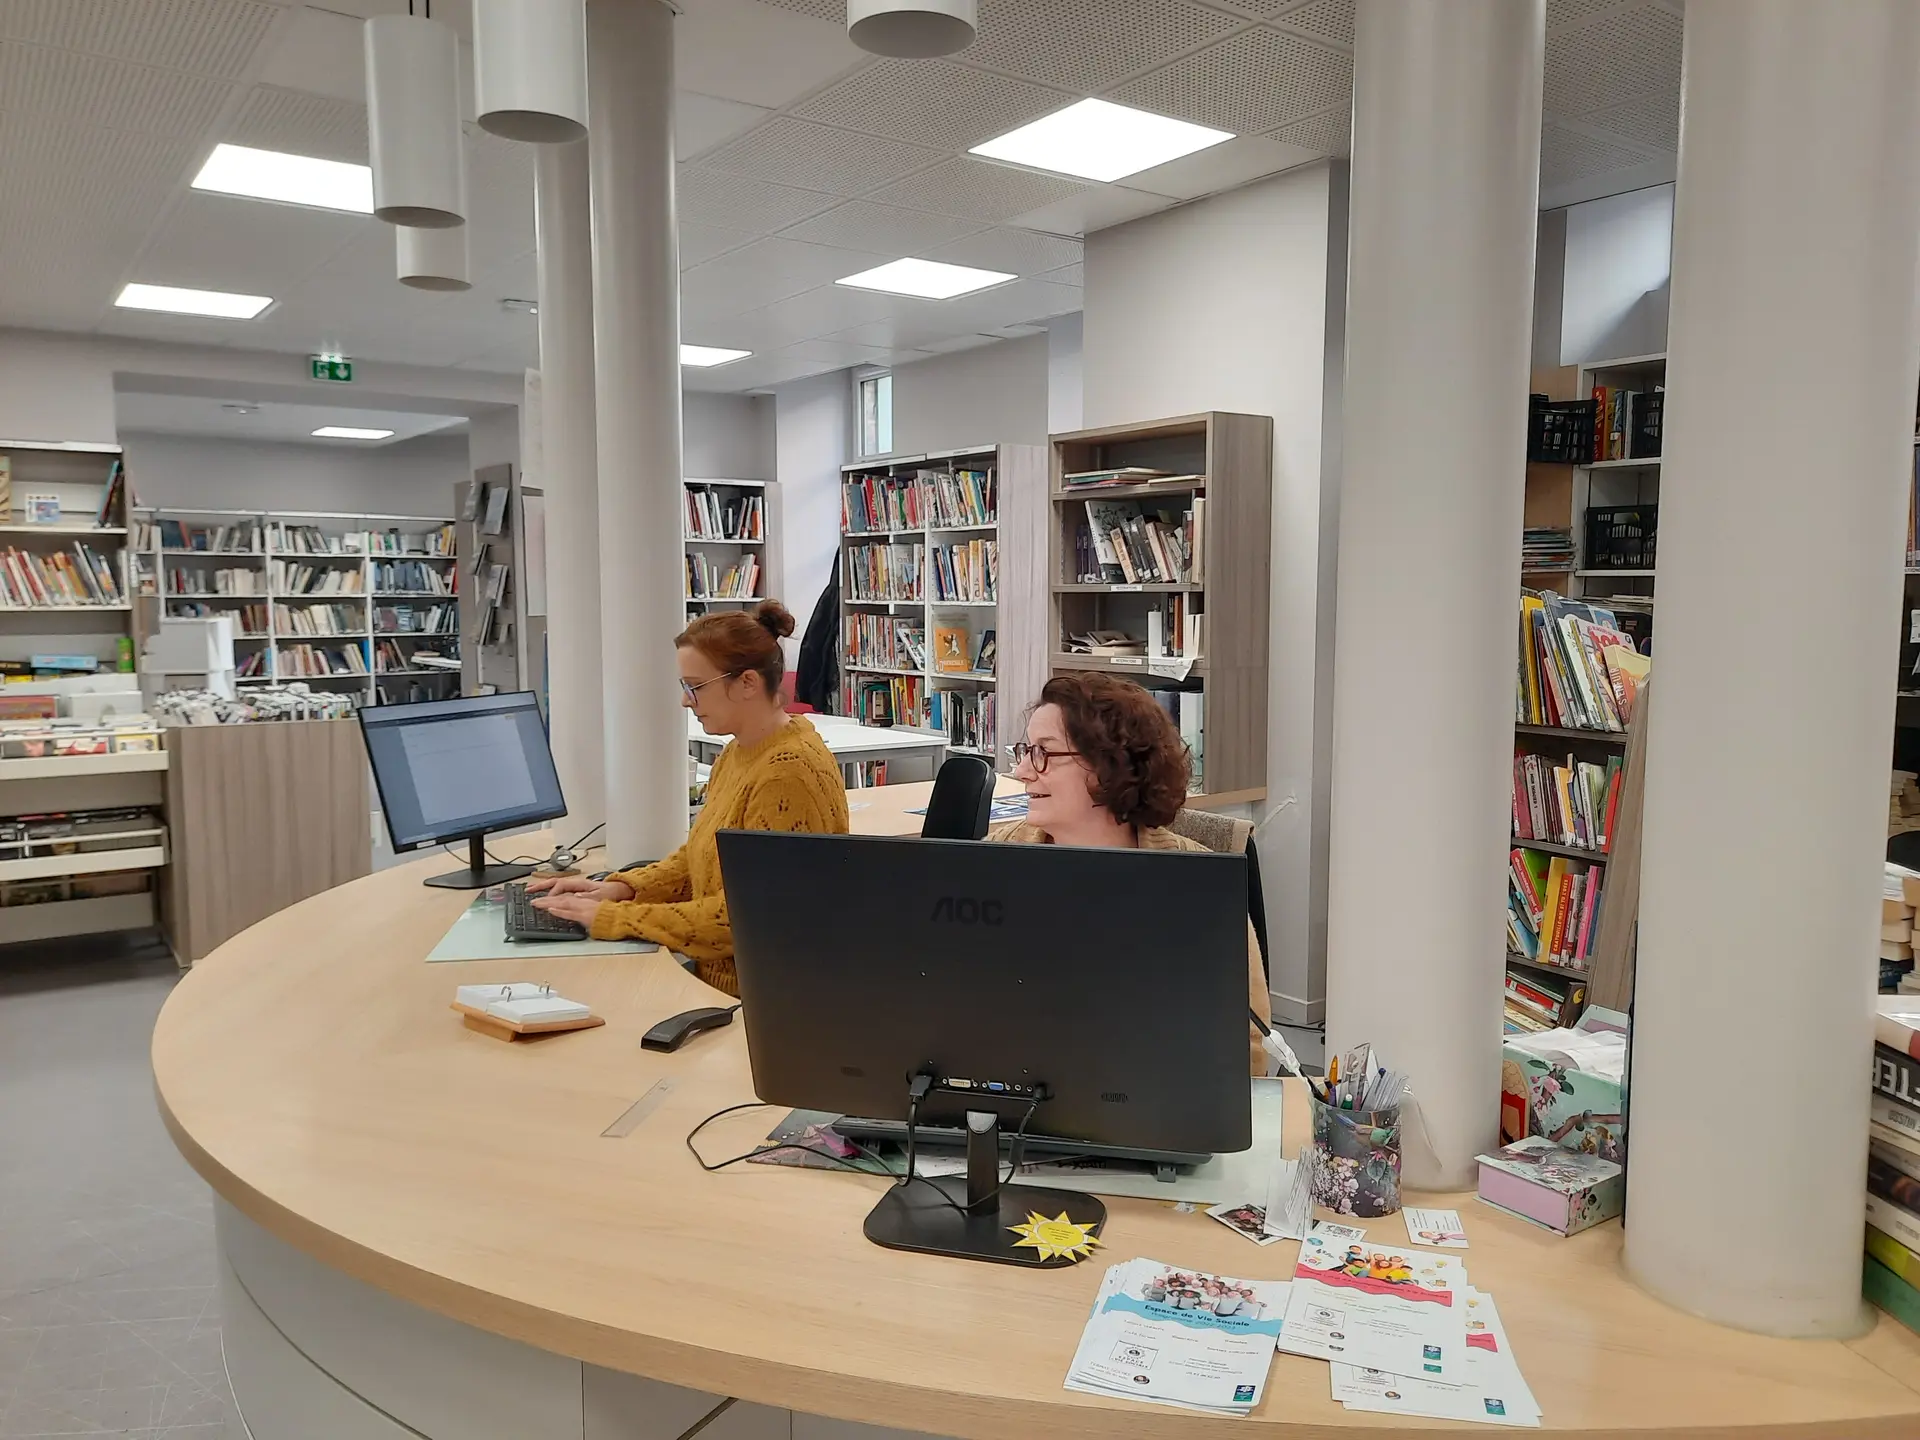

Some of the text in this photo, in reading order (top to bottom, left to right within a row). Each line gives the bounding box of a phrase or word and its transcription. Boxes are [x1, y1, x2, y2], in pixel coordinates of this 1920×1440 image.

[930, 897, 1004, 927] AOC
[1145, 1304, 1178, 1317] Espace
[1197, 1314, 1213, 1322] Vie
[1216, 1317, 1250, 1327] Sociale
